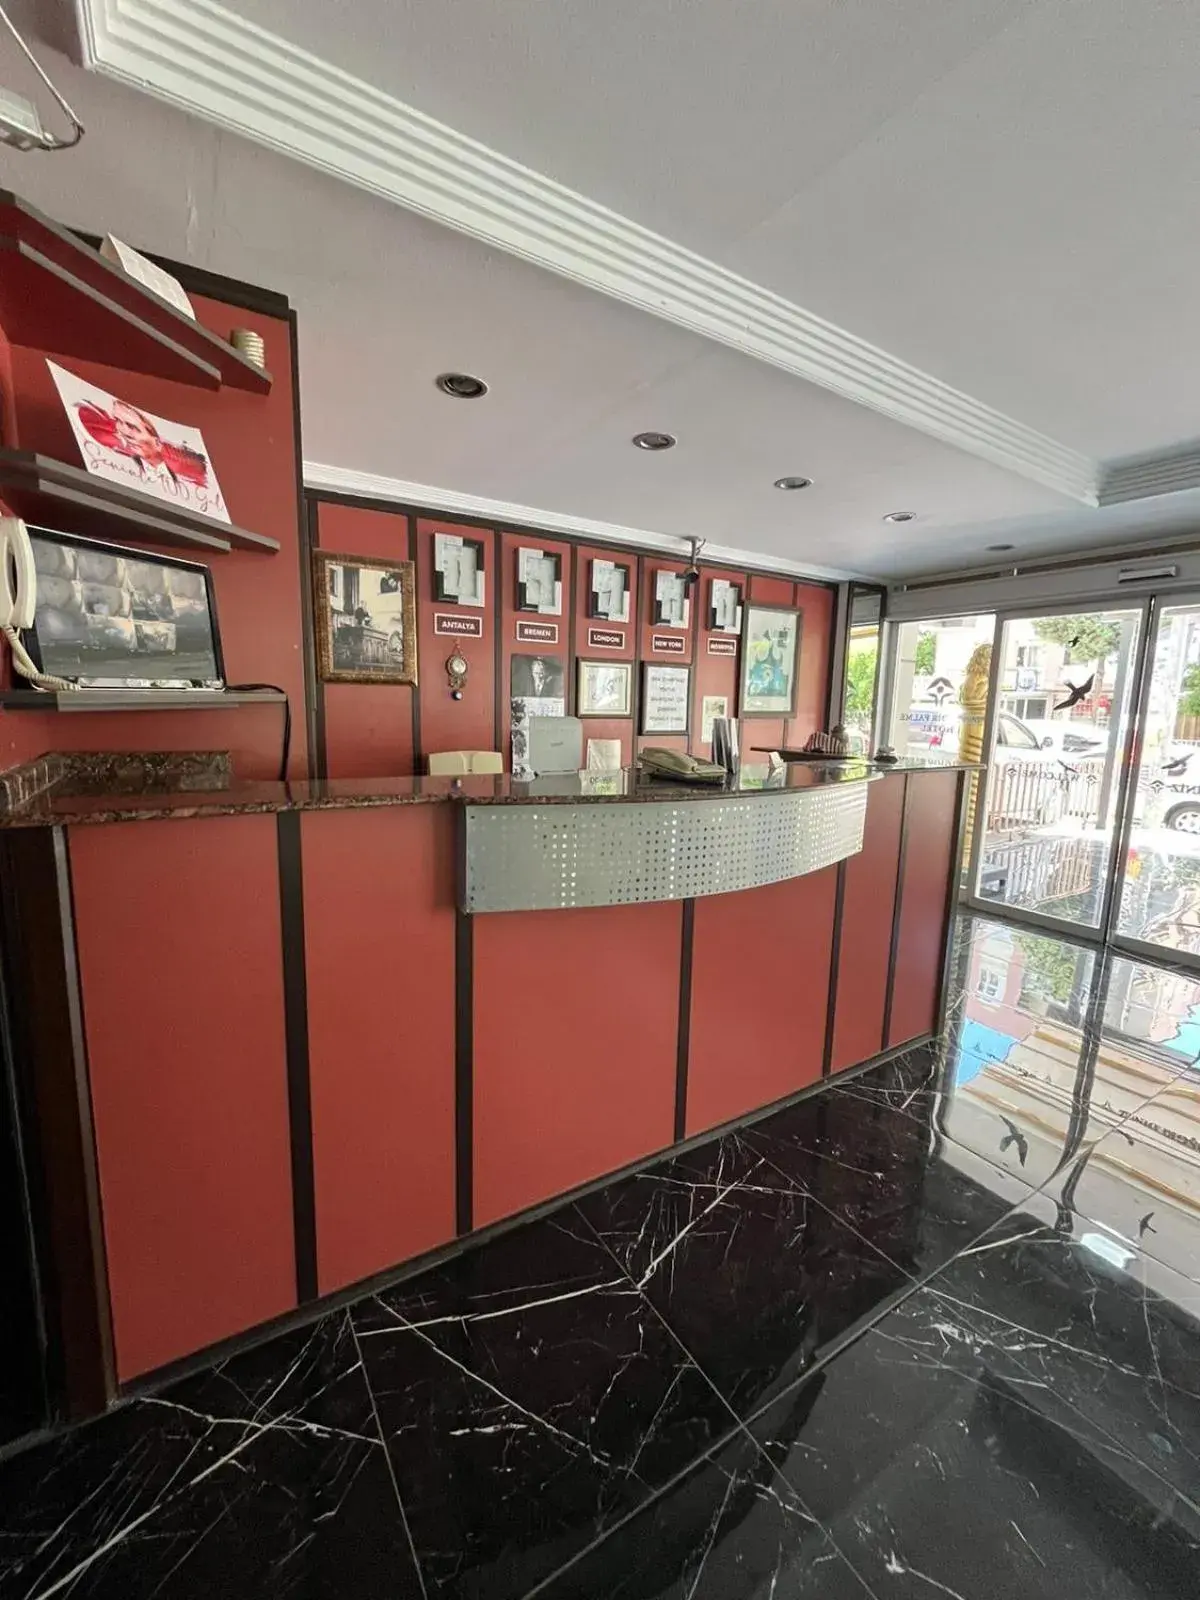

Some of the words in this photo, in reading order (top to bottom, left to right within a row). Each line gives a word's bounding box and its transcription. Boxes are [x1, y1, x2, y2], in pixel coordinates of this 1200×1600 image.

[441, 620, 476, 631] ANTALYA
[523, 628, 552, 637] BREMEN
[593, 634, 621, 643] LONDON
[669, 641, 682, 649] YORK
